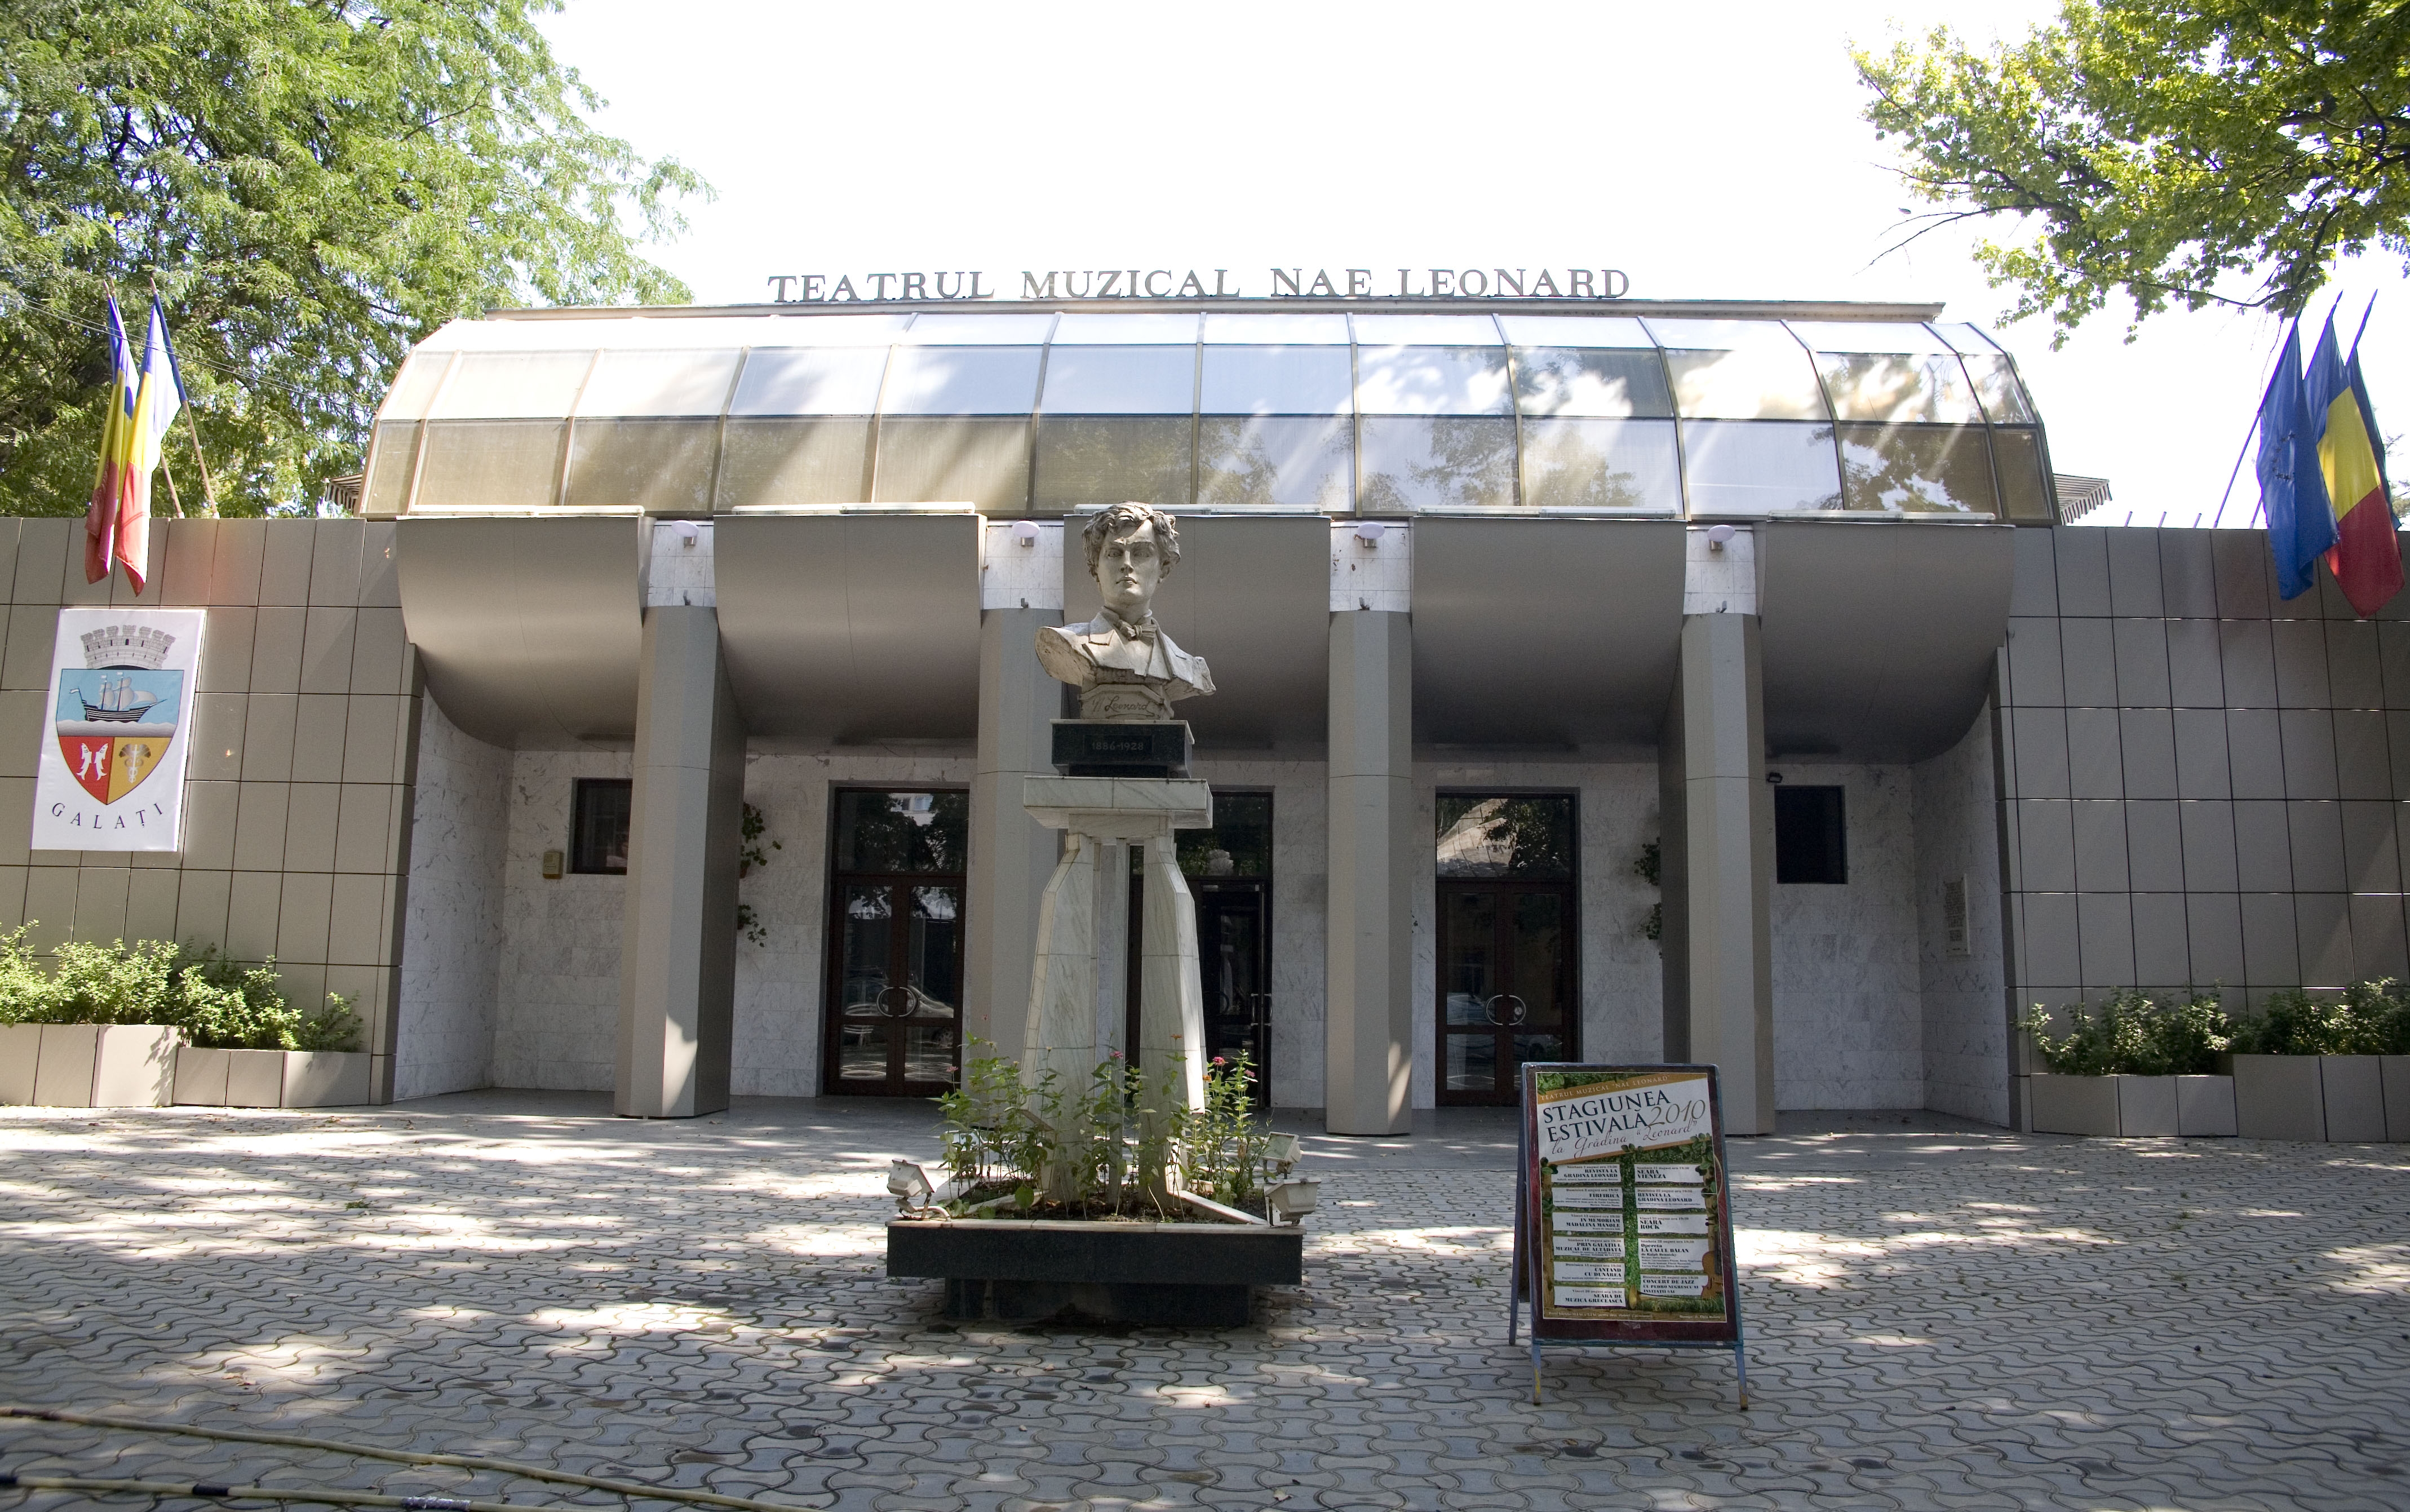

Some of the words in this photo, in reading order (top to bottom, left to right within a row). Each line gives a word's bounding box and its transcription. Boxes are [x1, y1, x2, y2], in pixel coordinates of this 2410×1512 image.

[768, 272, 994, 302] TEATRUL
[1020, 269, 1240, 298] MUZICAL
[1270, 268, 1371, 297] NAE
[1398, 268, 1629, 298] LEONARD
[1092, 741, 1144, 750] 1886-1928
[1540, 1091, 1572, 1101] TEATRUL
[1576, 1085, 1609, 1096] MUZICAL
[1543, 1090, 1671, 1123] STAGIUNEA
[1548, 1109, 1648, 1142] ESTIVALĂ
[1648, 1099, 1705, 1126] 2010
[1552, 1137, 1563, 1154] la
